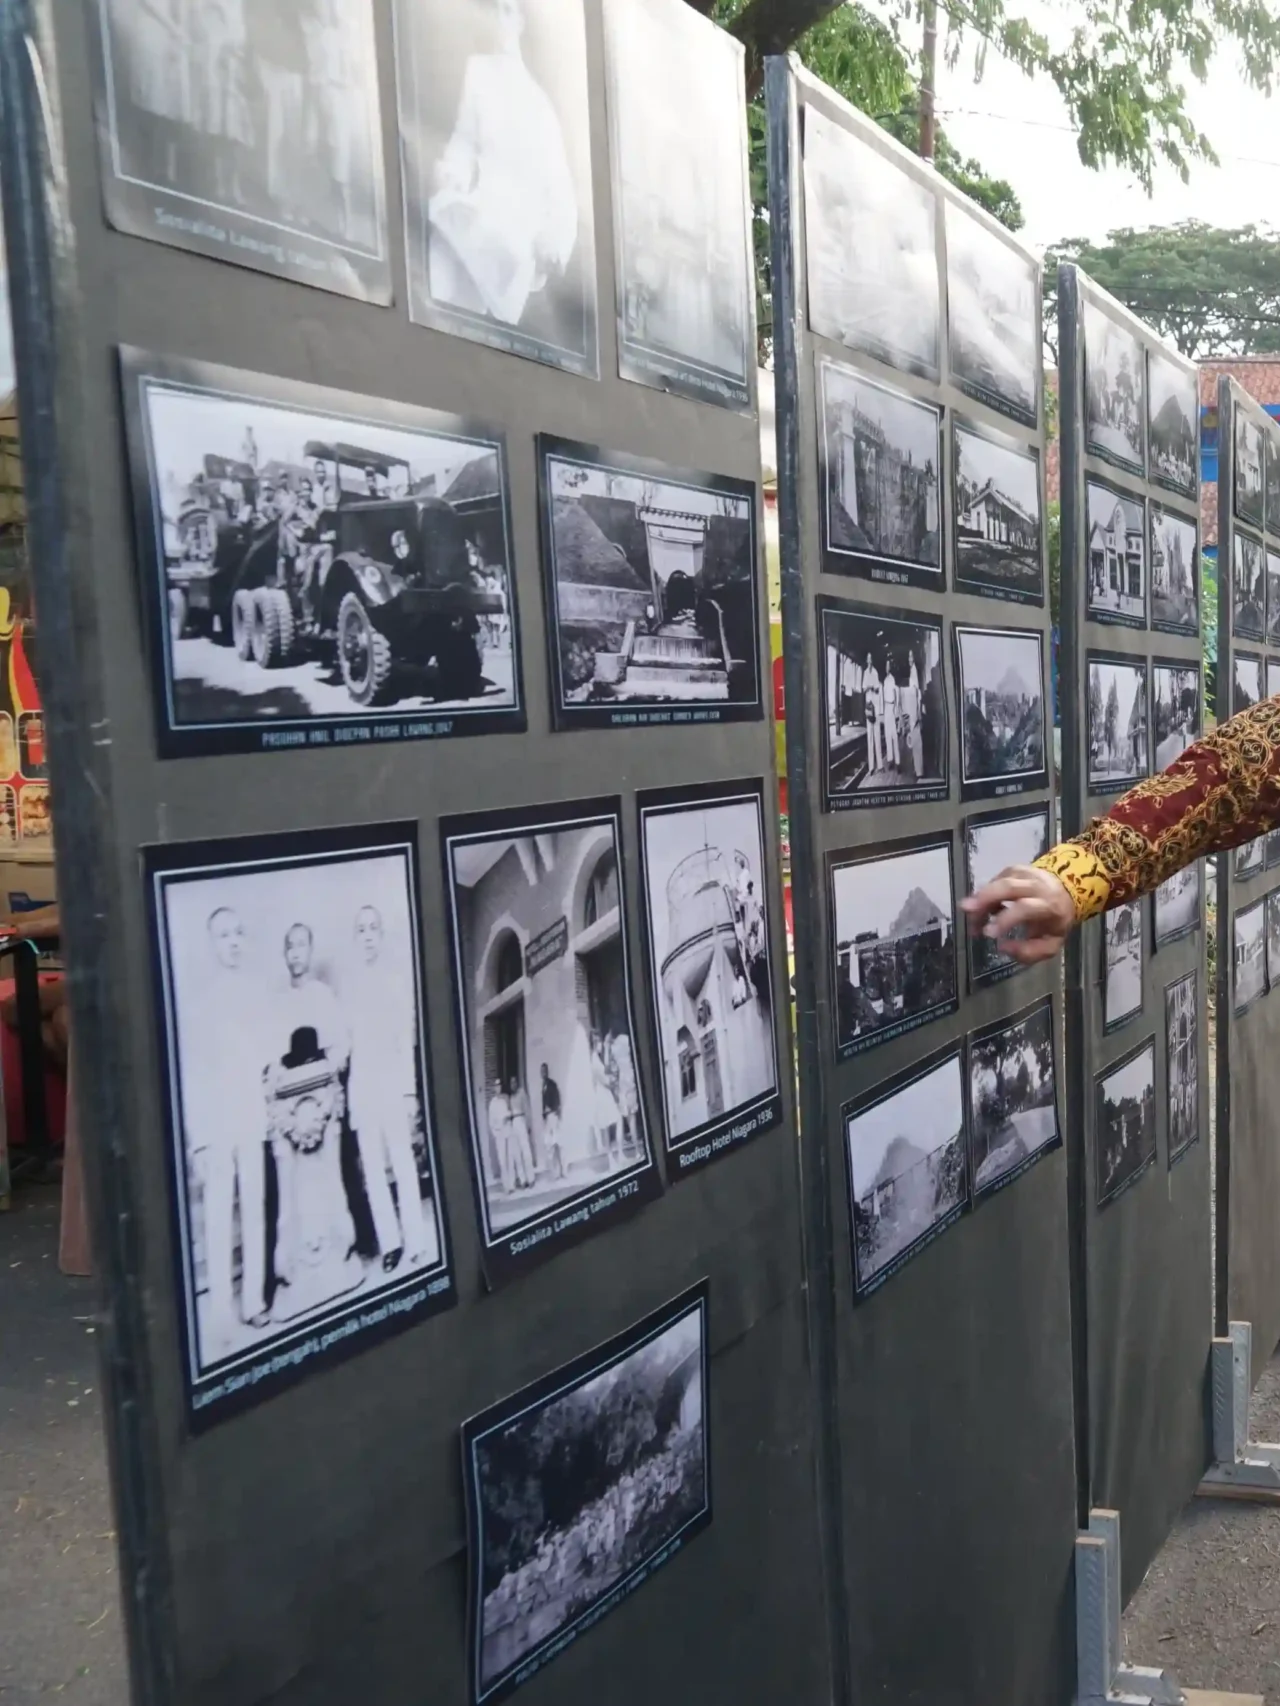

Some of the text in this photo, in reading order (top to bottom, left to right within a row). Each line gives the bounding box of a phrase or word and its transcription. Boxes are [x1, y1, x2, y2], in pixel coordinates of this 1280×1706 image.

[679, 1107, 773, 1168] Rooftop Hotel Niagara 1936
[510, 1180, 640, 1255] Sosialita Lawang tahun 1972
